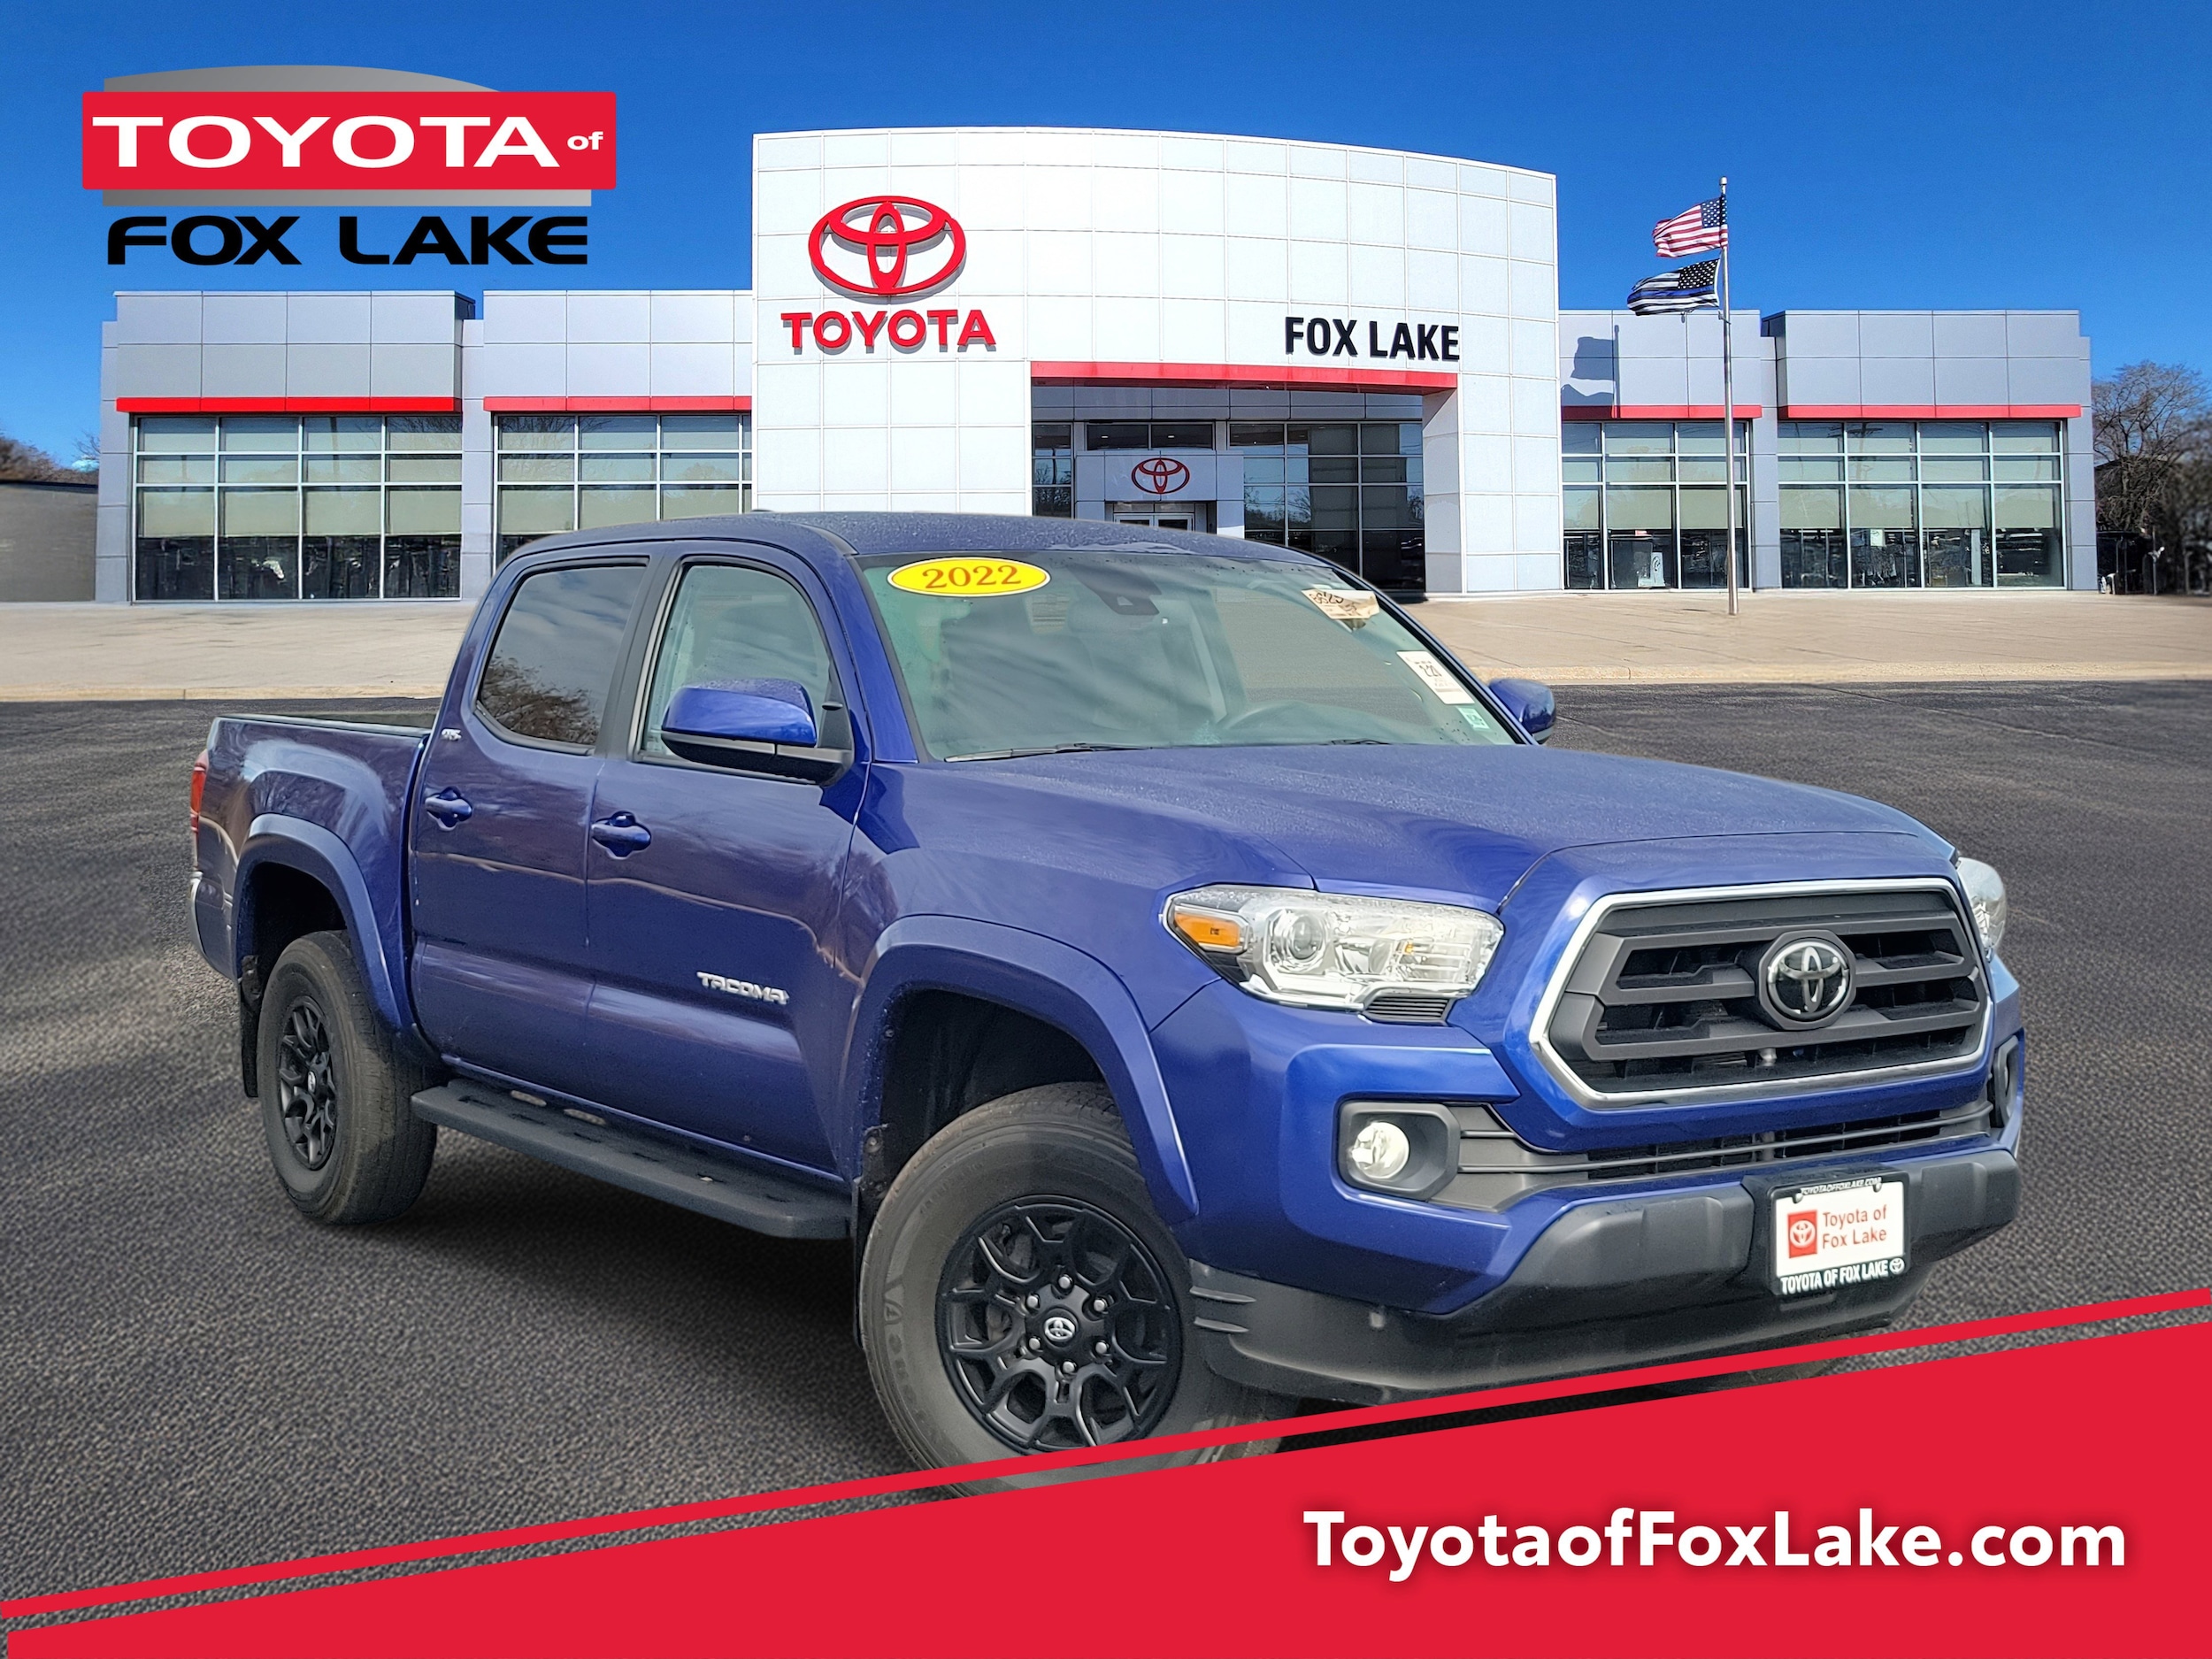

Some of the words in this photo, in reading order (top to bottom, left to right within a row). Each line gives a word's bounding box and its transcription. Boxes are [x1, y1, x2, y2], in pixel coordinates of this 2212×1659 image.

[780, 310, 997, 351] TOYOTA
[1286, 317, 1358, 357] FOX
[1369, 321, 1460, 361] LAKE
[922, 565, 1021, 589] 2022
[696, 972, 790, 1005] TACOMA
[1823, 1208, 1868, 1230] Toyota
[1873, 1204, 1887, 1220] of
[1823, 1233, 1847, 1249] Fox
[1853, 1227, 1887, 1245] Lake
[1780, 1271, 1823, 1295] TOYOTA
[1824, 1268, 1839, 1287] OF
[1839, 1264, 1862, 1286] FOX
[1862, 1260, 1889, 1280] LAKE
